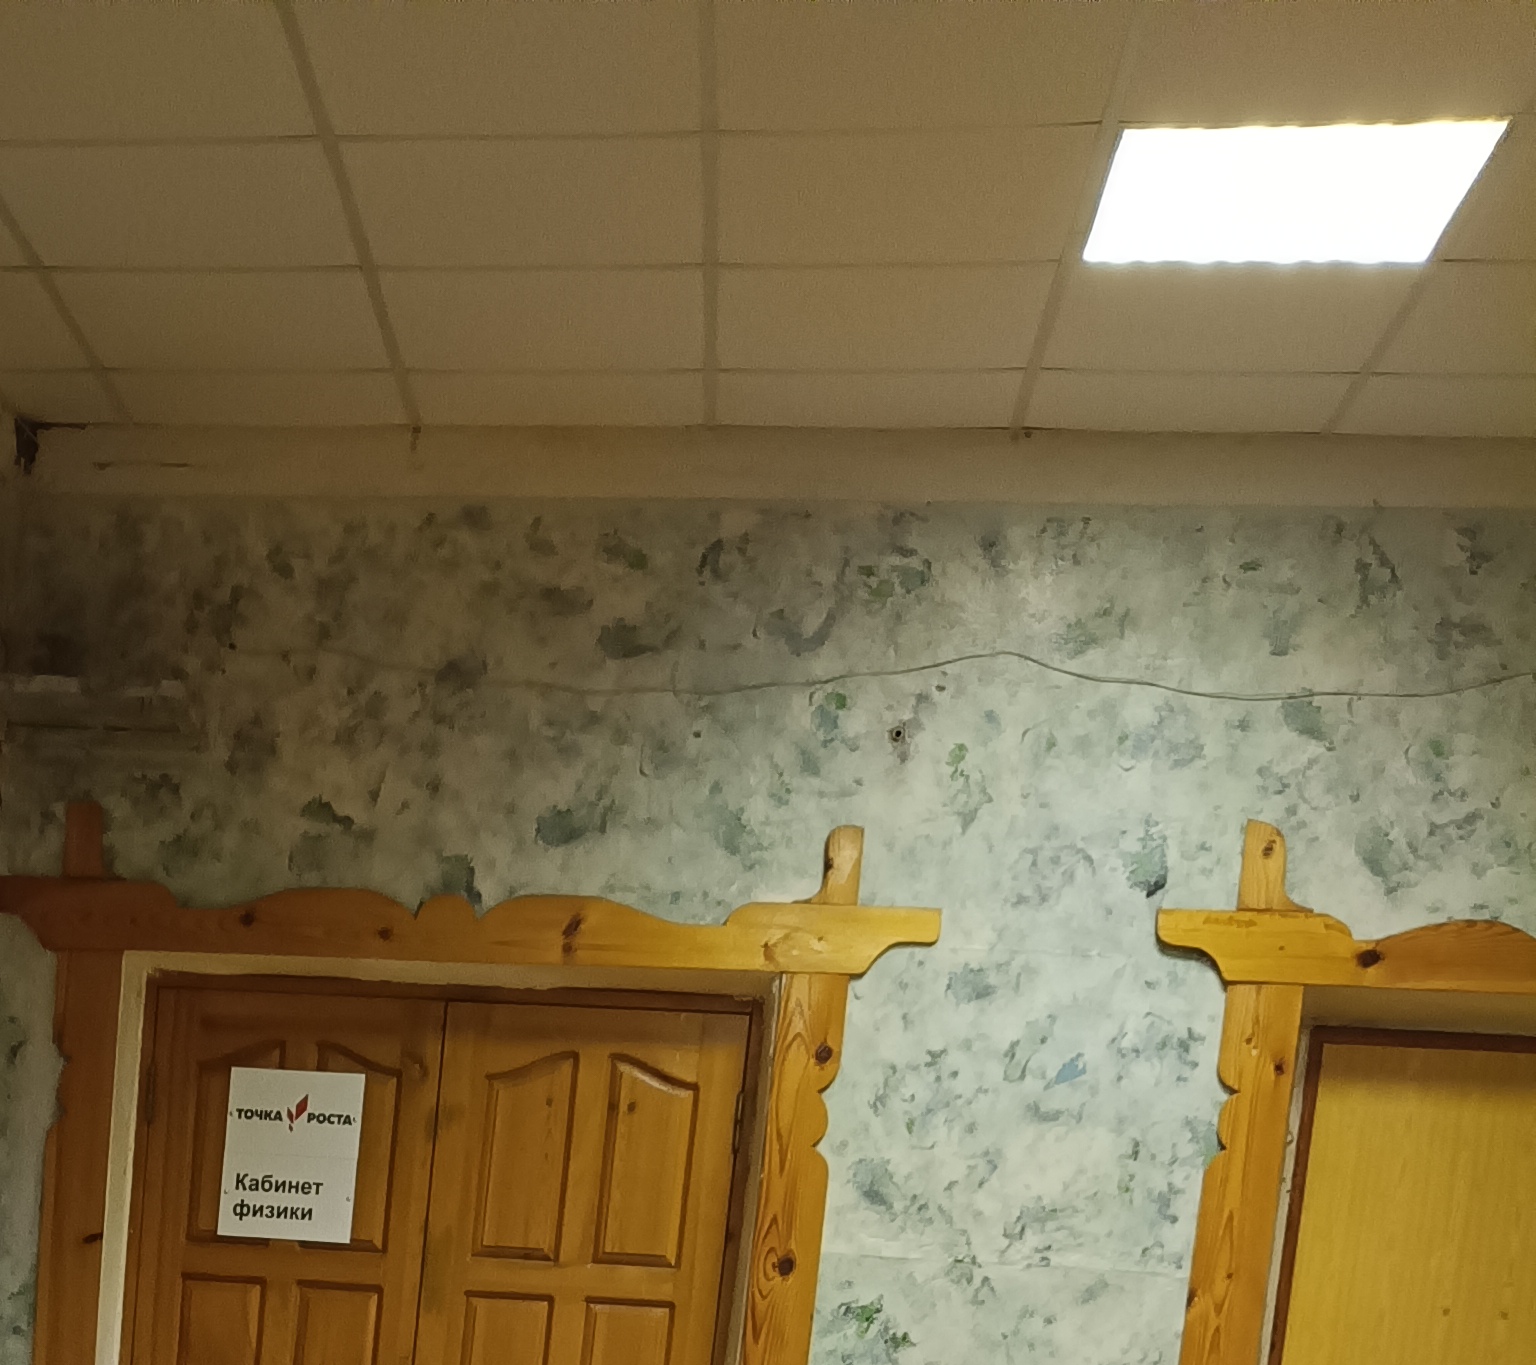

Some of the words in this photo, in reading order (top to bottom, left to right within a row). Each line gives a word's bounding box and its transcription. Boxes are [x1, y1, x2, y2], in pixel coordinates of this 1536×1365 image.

[235, 1107, 283, 1122] ТОЧКА
[306, 1112, 353, 1126] РОСТА
[234, 1172, 324, 1196] Кабинет
[231, 1198, 314, 1222] физики
